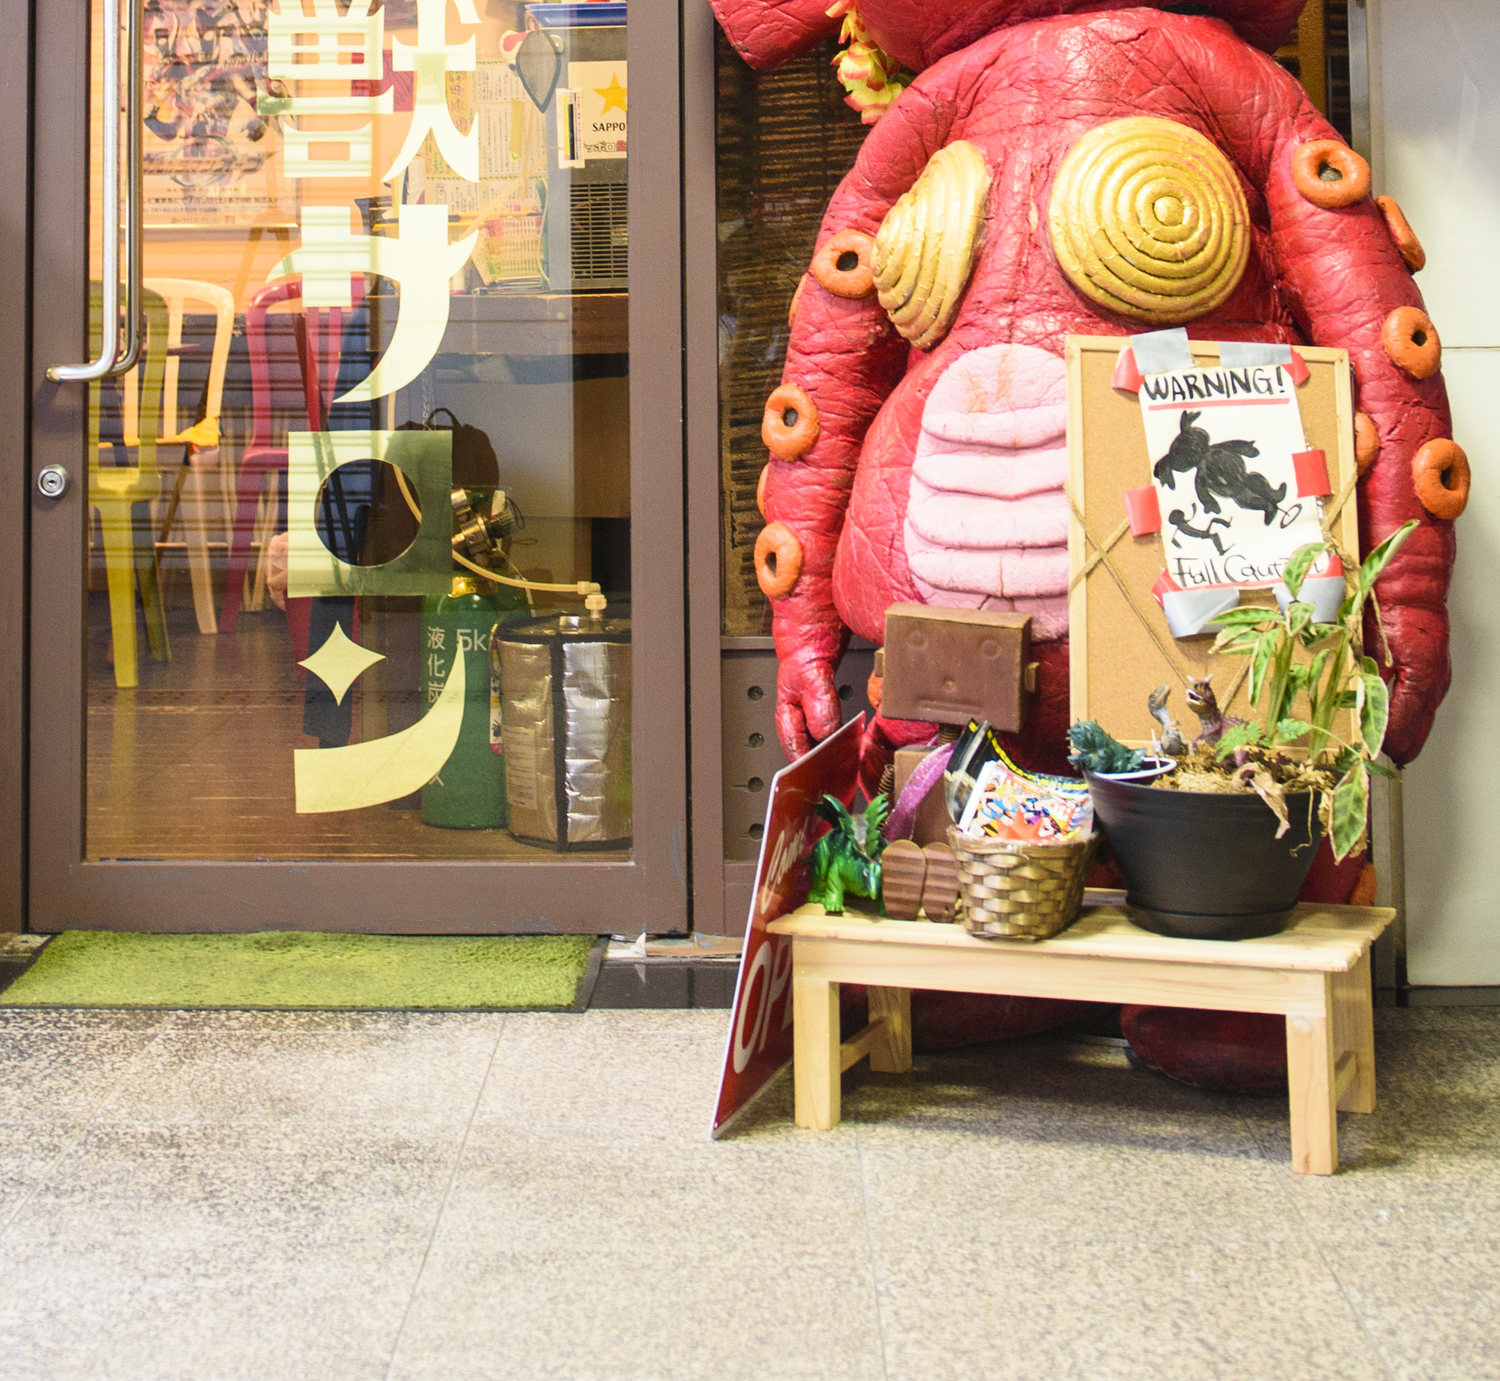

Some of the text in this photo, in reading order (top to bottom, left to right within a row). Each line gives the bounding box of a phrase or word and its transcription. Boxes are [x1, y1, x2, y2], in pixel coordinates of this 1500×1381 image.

[592, 122, 626, 132] SAPPO
[1144, 366, 1286, 401] WARNING!
[1173, 556, 1220, 586] Fall
